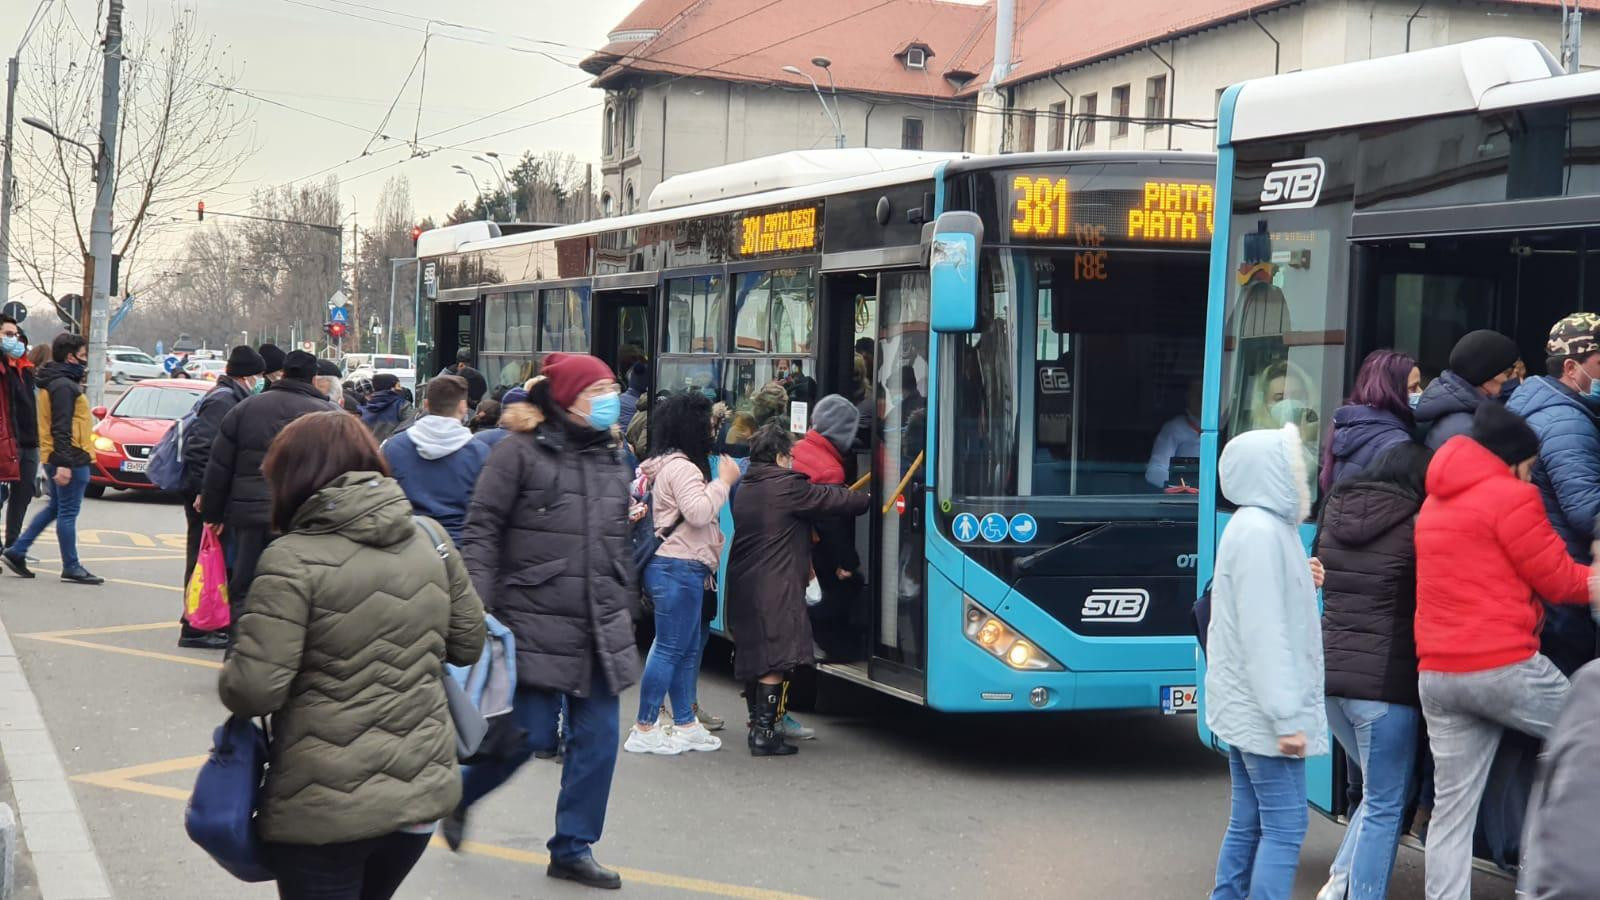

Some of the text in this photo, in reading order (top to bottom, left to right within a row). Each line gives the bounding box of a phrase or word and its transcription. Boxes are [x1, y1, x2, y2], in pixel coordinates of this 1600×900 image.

[1144, 182, 1213, 211] PIATA
[1260, 165, 1320, 203] STB
[1013, 176, 1067, 235] 381
[740, 216, 761, 254] 381
[1128, 209, 1197, 239] PIATA
[1081, 594, 1143, 616] STB
[1173, 689, 1184, 707] B
